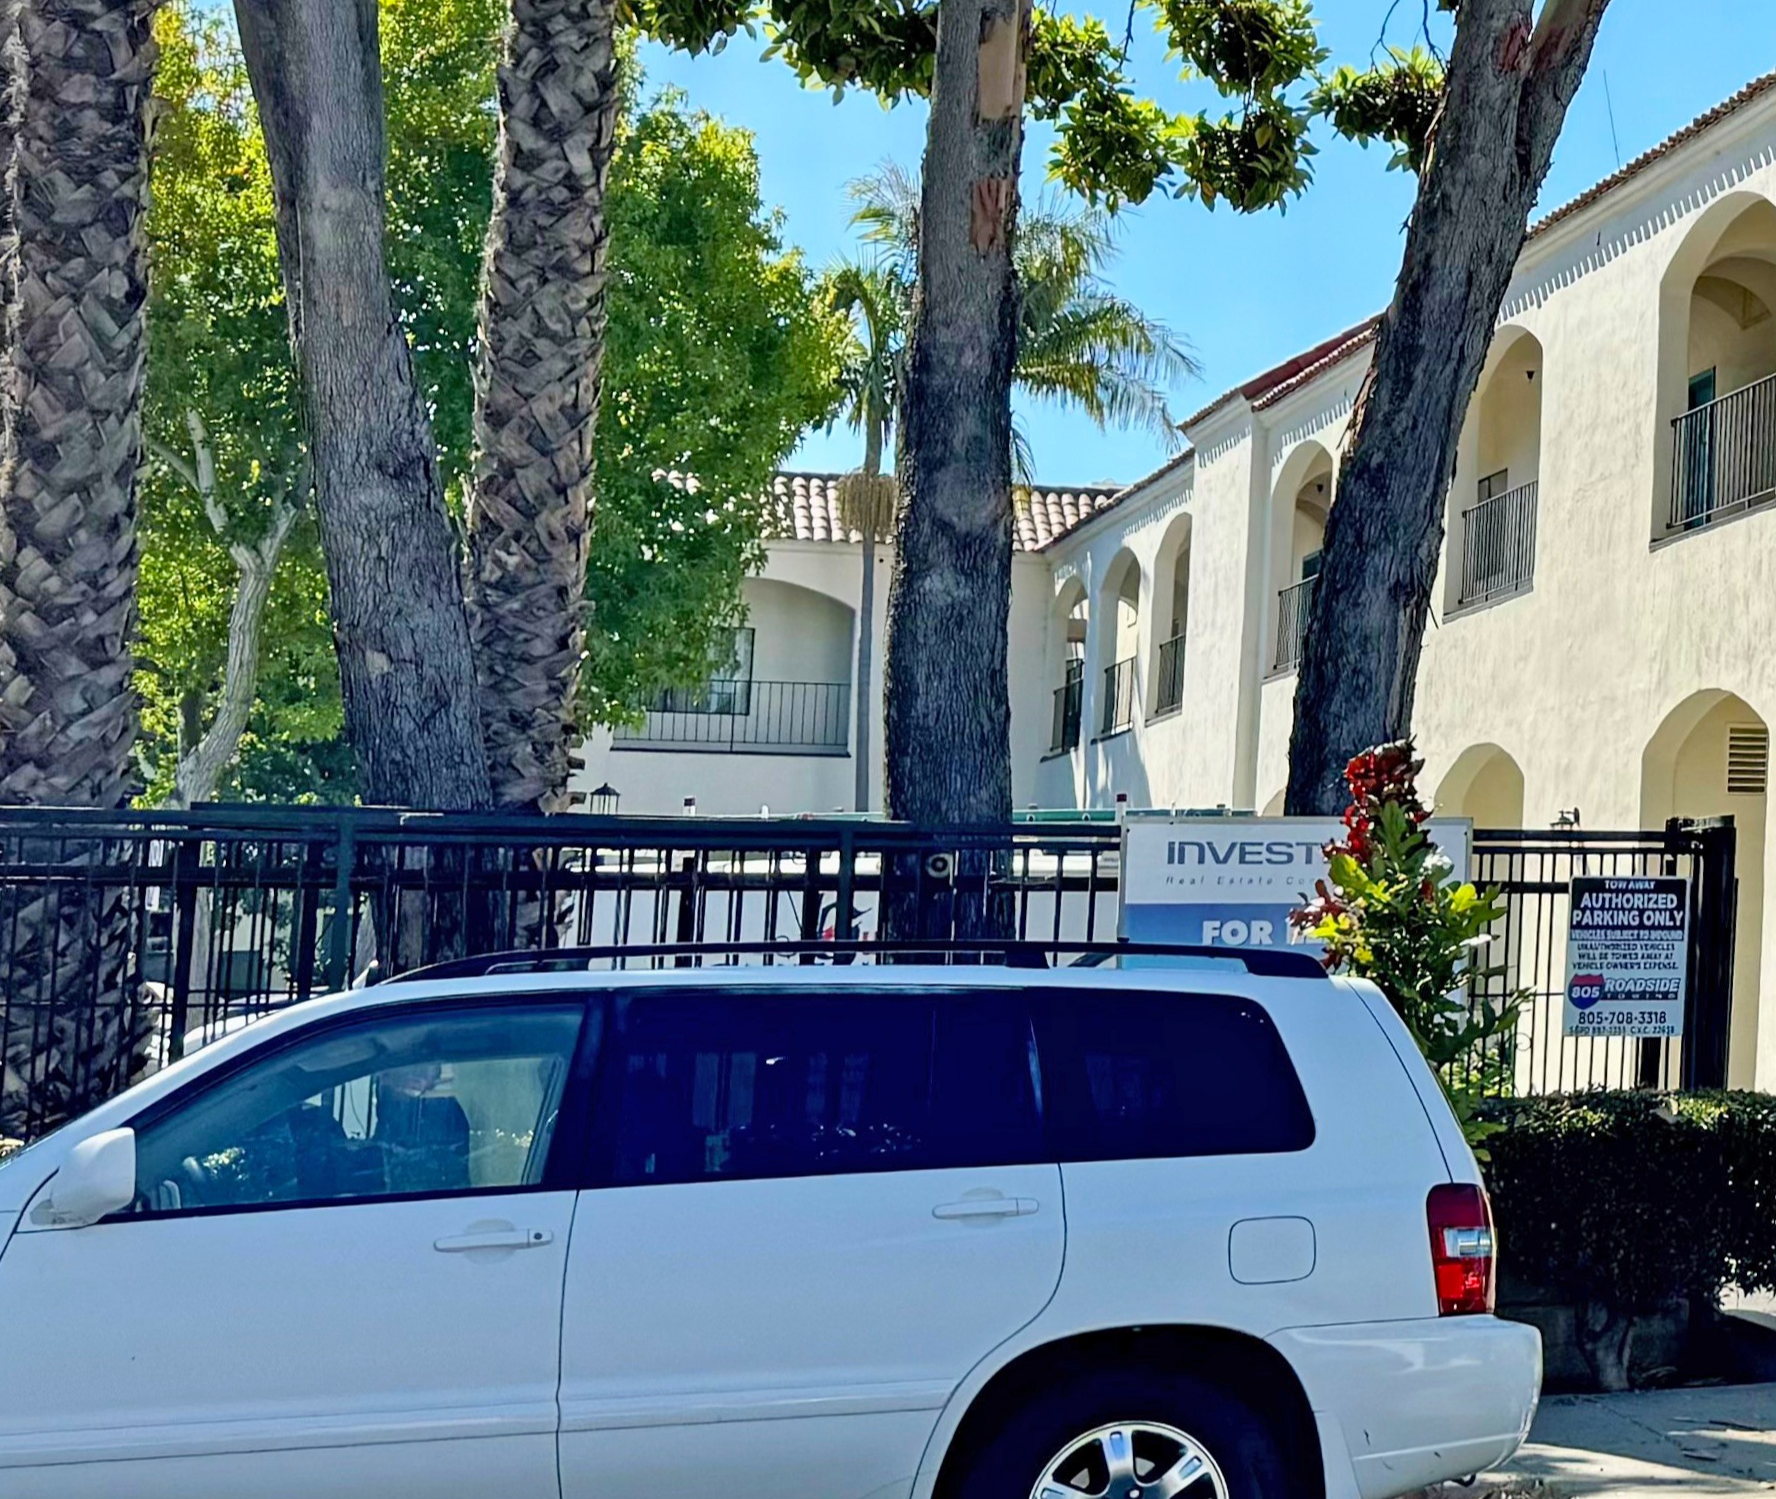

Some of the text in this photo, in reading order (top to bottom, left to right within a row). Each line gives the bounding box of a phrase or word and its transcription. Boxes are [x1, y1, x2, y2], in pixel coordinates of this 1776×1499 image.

[1167, 841, 1322, 865] INVEST
[1166, 875, 1205, 885] Real
[1217, 875, 1273, 885] Estate
[1605, 880, 1656, 890] TOW AWAY
[1580, 892, 1678, 909] AUTHORIZED
[1572, 910, 1684, 926] PARKING ONLY
[1202, 920, 1274, 946] FOR
[1571, 986, 1600, 998] 805
[1605, 978, 1681, 993] ROADSIDE
